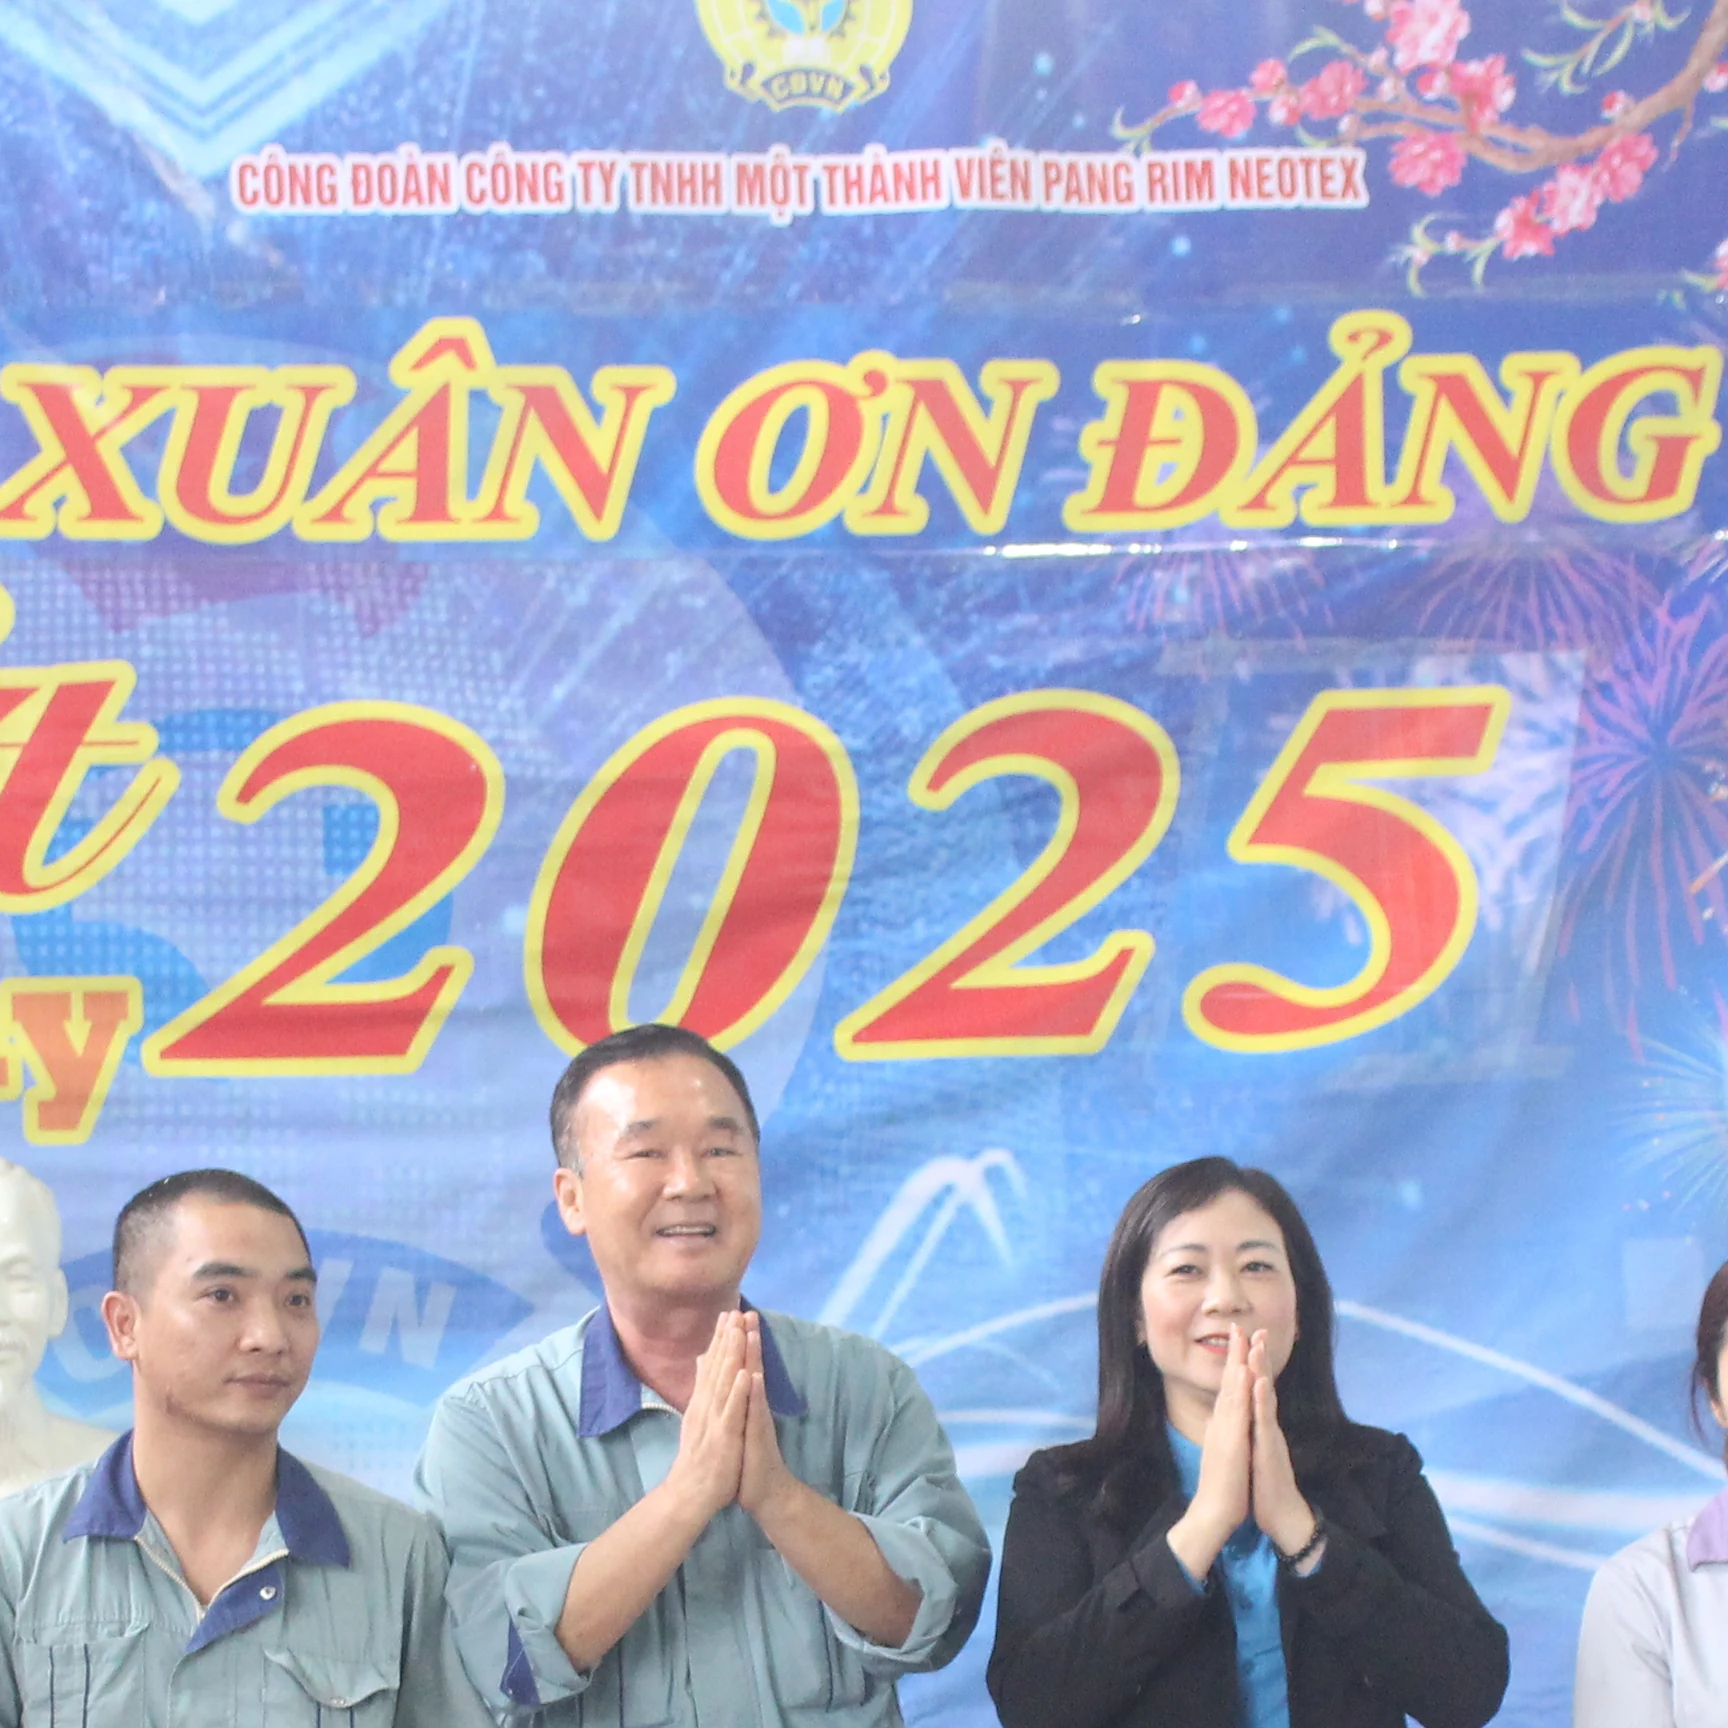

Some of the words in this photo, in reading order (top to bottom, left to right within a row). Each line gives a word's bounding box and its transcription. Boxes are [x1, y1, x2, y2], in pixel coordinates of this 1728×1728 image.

[236, 150, 339, 208] CÔNG
[348, 148, 453, 208] ĐOÀN
[463, 147, 565, 208] CÔNG
[576, 158, 621, 206] TY
[627, 159, 722, 208] TNHH
[734, 149, 813, 217] MỘT
[819, 150, 944, 205] THÀNH
[950, 149, 1033, 203] VIÊN
[1040, 160, 1136, 207] PANG
[1145, 158, 1216, 206] RIM
[1226, 154, 1362, 203] NEOTEX
[704, 358, 1051, 532] ƠN
[1073, 319, 1714, 522] ĐẢNG
[152, 693, 1503, 1068] 2025
